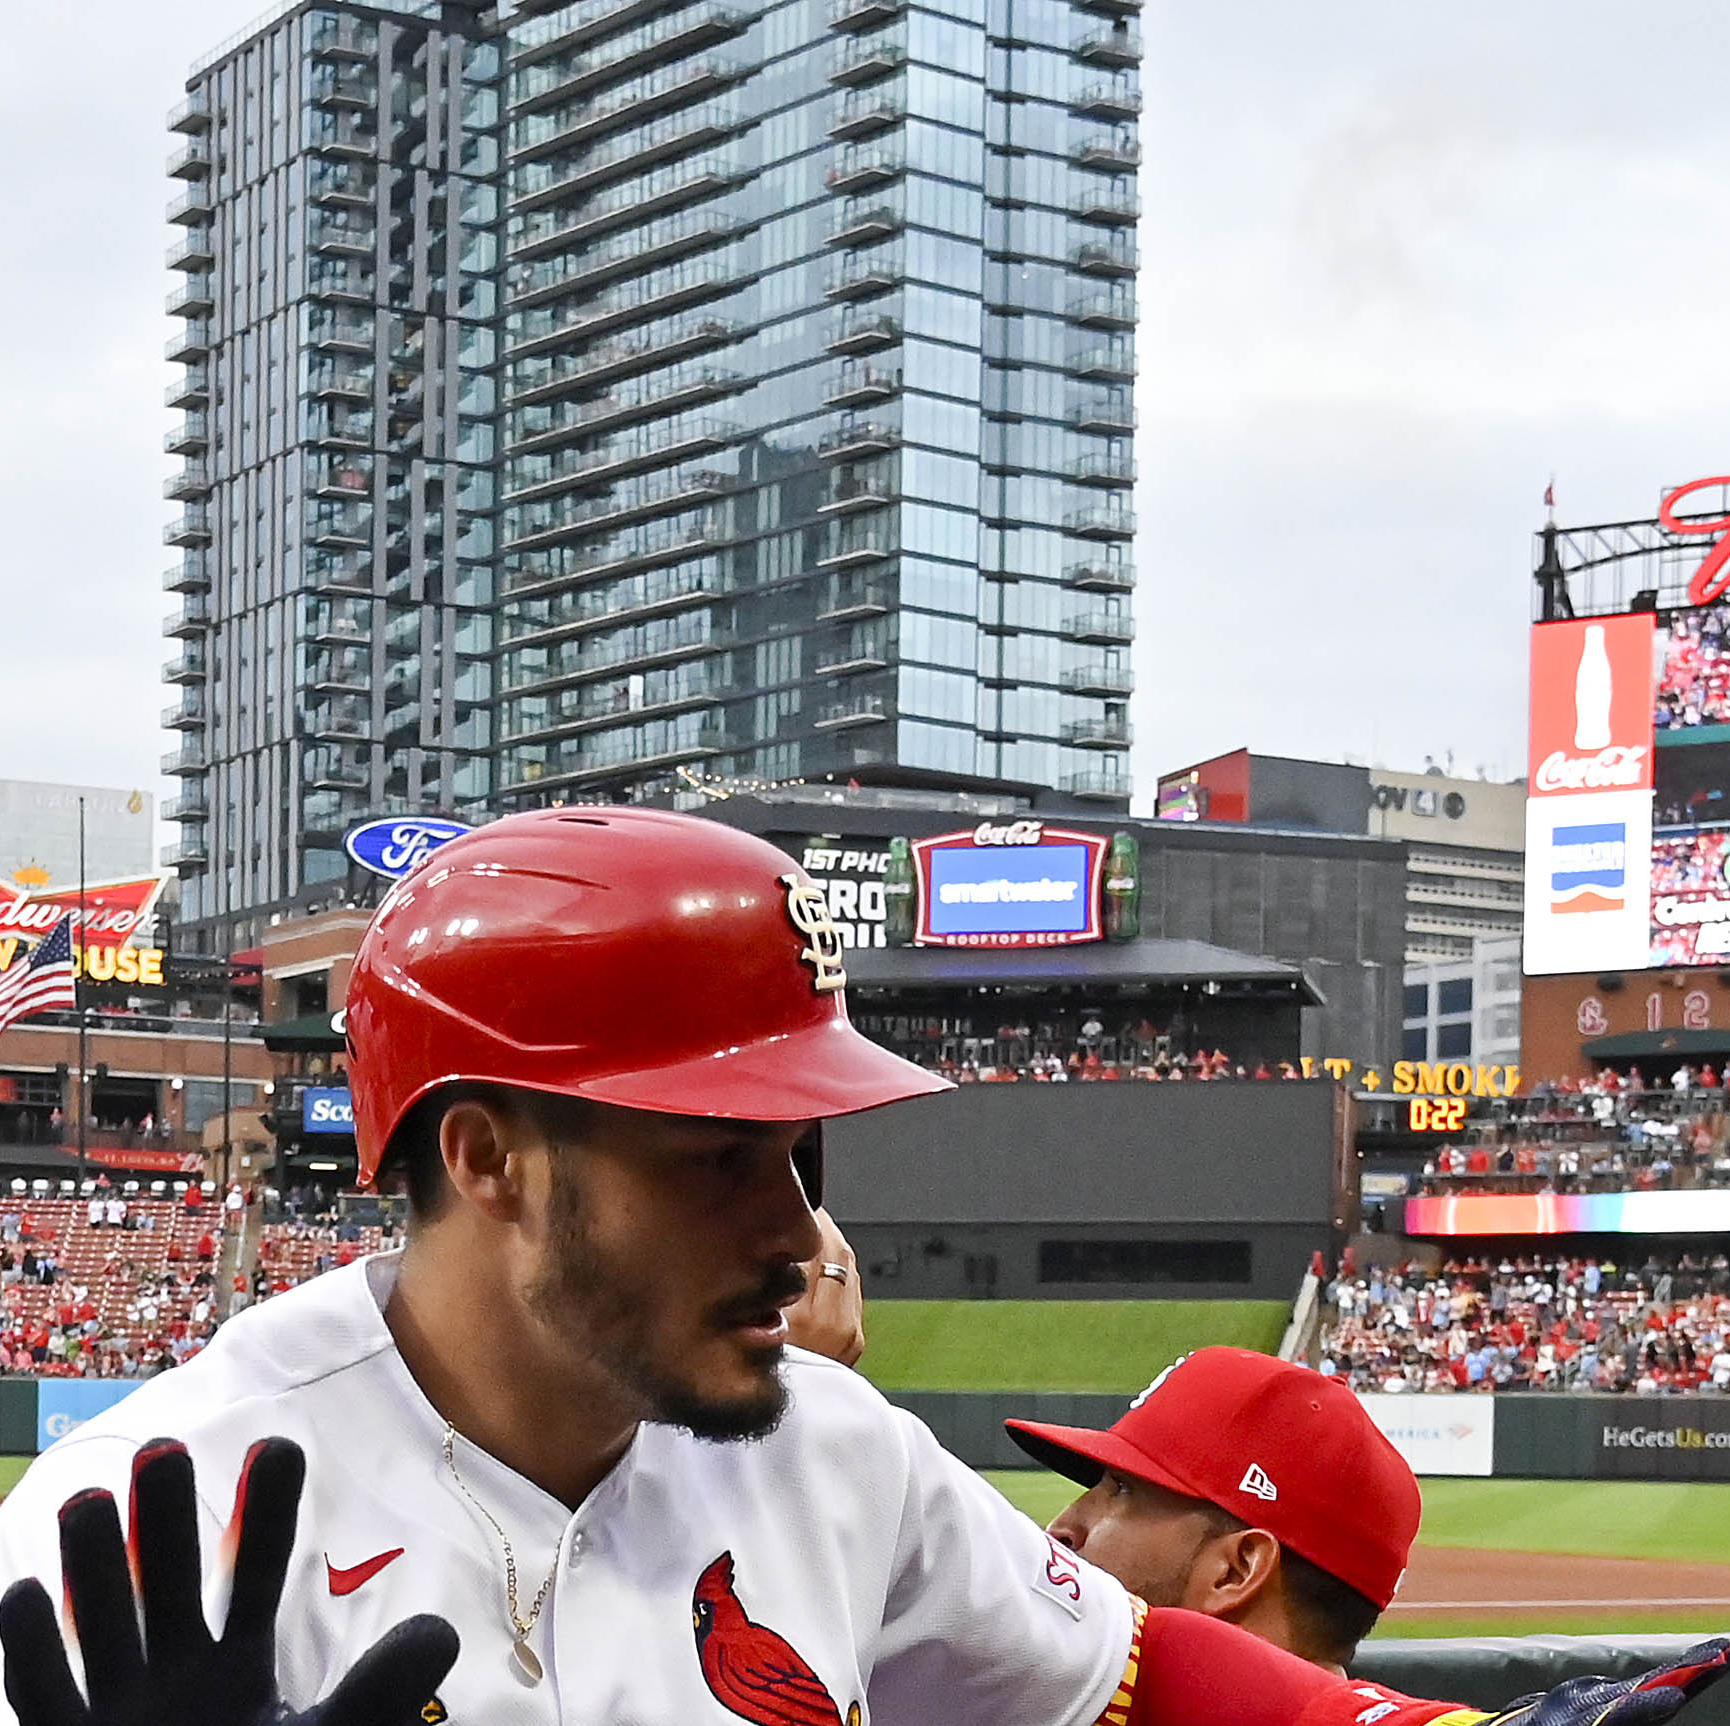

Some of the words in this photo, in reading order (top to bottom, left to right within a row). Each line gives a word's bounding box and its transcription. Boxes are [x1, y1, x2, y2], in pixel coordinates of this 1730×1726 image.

[947, 934, 1018, 946] ROOFTOP
[1026, 933, 1068, 945] DECK
[1646, 992, 1662, 1032] 1
[1683, 990, 1710, 1030] 2
[1410, 1097, 1467, 1131] 0:22
